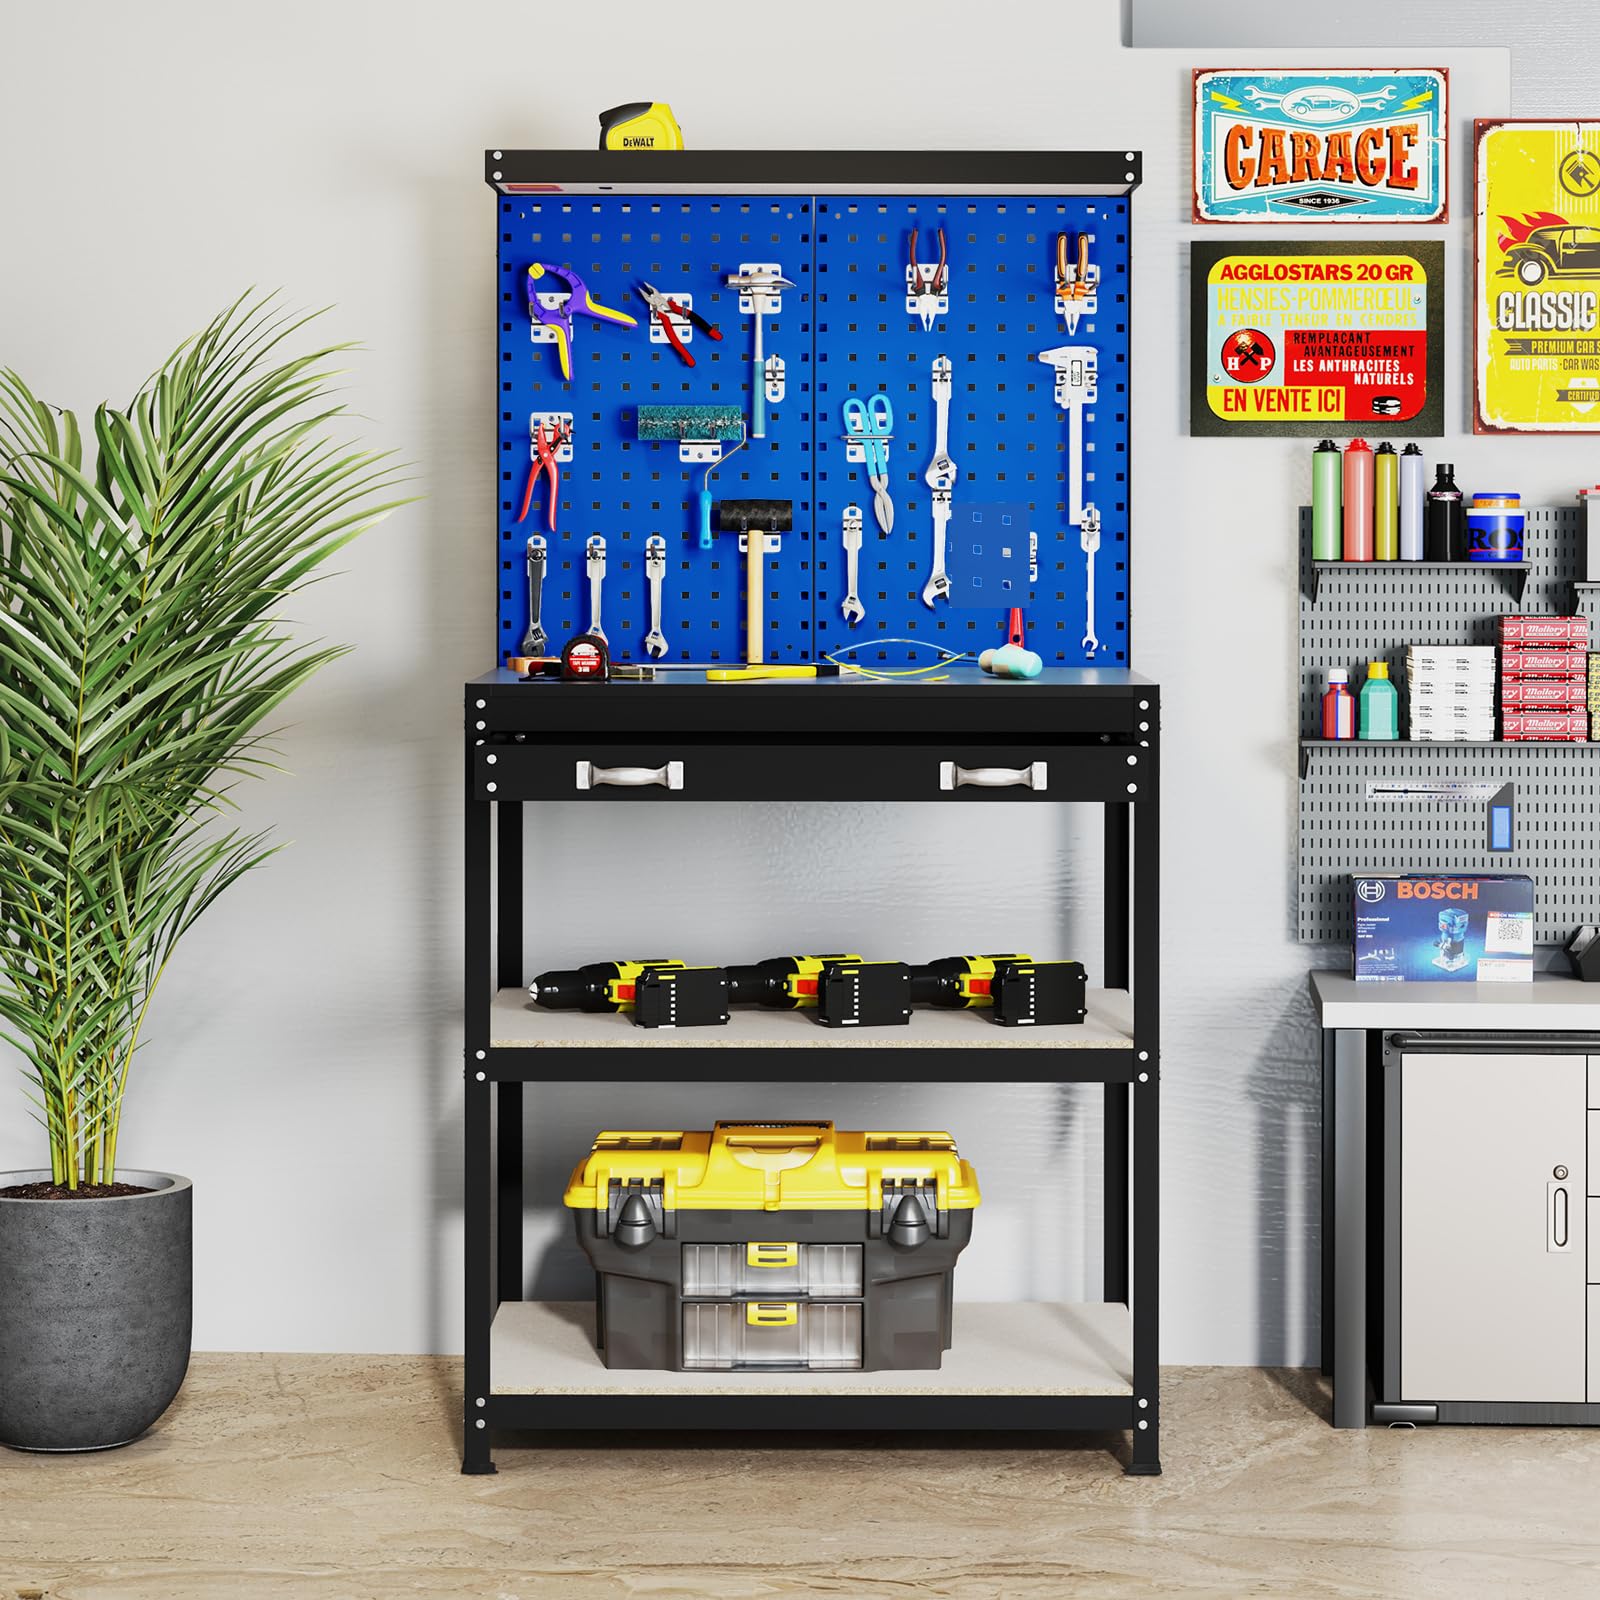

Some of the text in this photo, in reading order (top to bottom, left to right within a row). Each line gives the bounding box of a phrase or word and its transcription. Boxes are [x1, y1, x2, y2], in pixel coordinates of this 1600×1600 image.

[1224, 123, 1418, 191] GARAGE
[1220, 263, 1414, 281] AGGLOSTARS 20 GR
[1497, 291, 1597, 332] CLASSIC
[1231, 313, 1272, 327] FAIBLE
[1280, 313, 1329, 327] TENEUR
[1336, 313, 1353, 327] EN
[1360, 313, 1417, 327] CENDRES
[1304, 345, 1415, 357] AVANTAGEUSEMENT
[1531, 341, 1574, 354] PREMIUM
[1576, 341, 1595, 354] CAR
[1227, 357, 1272, 371] H P
[1293, 359, 1400, 372] LES ANTHRACITES
[1510, 358, 1530, 371] AUTO
[1532, 358, 1558, 371] PARTS
[1562, 358, 1579, 371] CAR
[1354, 373, 1414, 385] NATURELS
[1224, 388, 1341, 412] EN VENTE ICI
[1527, 625, 1566, 635] Mallory
[1526, 657, 1565, 667] Mallory
[1526, 688, 1565, 698] Mallory
[1527, 719, 1566, 730] Mallory
[1397, 882, 1479, 900] BOSCH
